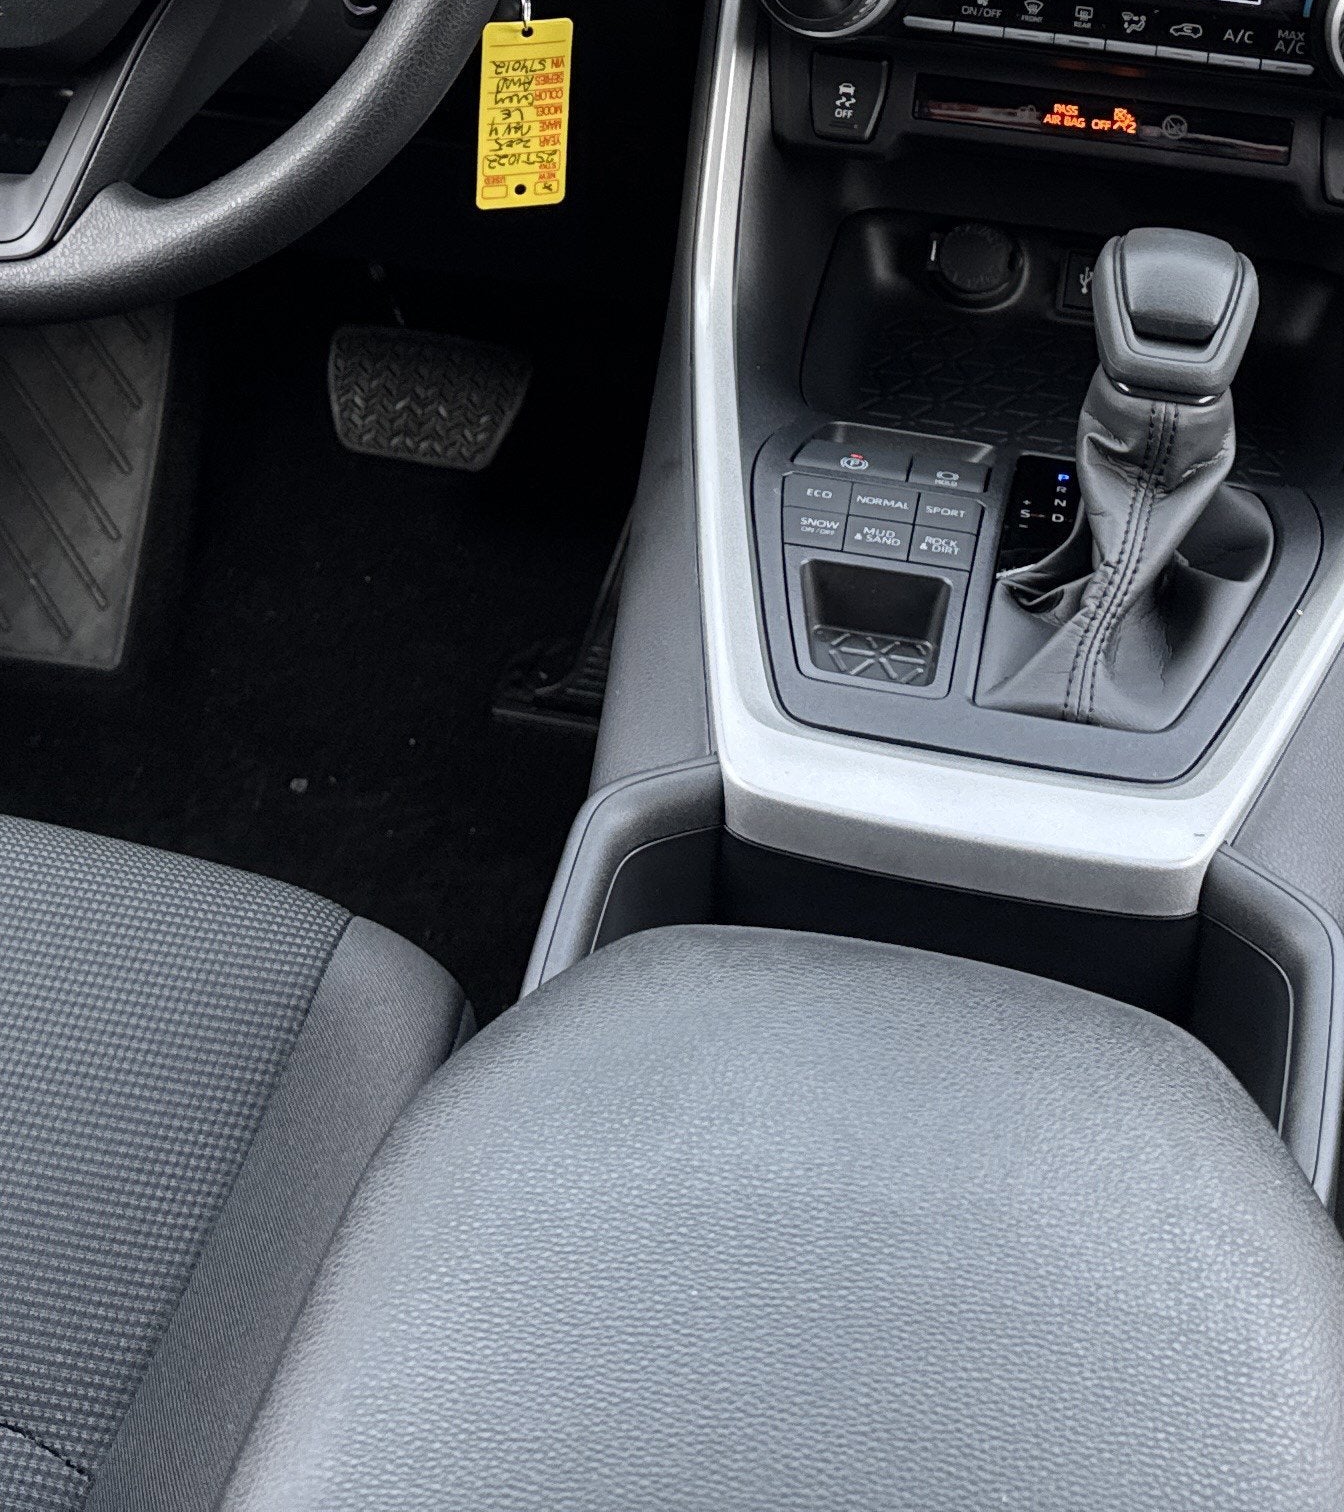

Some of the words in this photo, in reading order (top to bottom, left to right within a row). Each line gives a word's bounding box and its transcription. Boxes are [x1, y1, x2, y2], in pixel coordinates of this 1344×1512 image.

[1073, 20, 1092, 29] REAR
[1222, 28, 1254, 44] A/C
[1277, 29, 1305, 39] MAX
[1274, 39, 1306, 55] A/C
[550, 56, 565, 68] VIN
[534, 88, 564, 102] COLOR
[535, 105, 562, 116] MODEL
[834, 108, 853, 119] OFF
[1053, 103, 1079, 116] PASS
[538, 120, 562, 132] MAKE
[1043, 113, 1062, 125] AIR
[1063, 116, 1086, 129] BAG
[1091, 118, 1111, 131] OFF
[538, 135, 561, 147] YEAR
[537, 171, 556, 181] NEW
[1058, 473, 1070, 481] P
[806, 488, 833, 499] ECO
[1056, 485, 1067, 493] R
[856, 495, 910, 510] NORMAL
[1054, 498, 1067, 507] N
[925, 505, 966, 518] SPORT
[1020, 509, 1031, 518] S
[800, 517, 840, 529] SNOW
[1051, 513, 1065, 523] D
[863, 526, 897, 539] MUD
[865, 535, 902, 547] SAND
[924, 535, 959, 547] ROCK
[931, 544, 962, 556] DIRT
